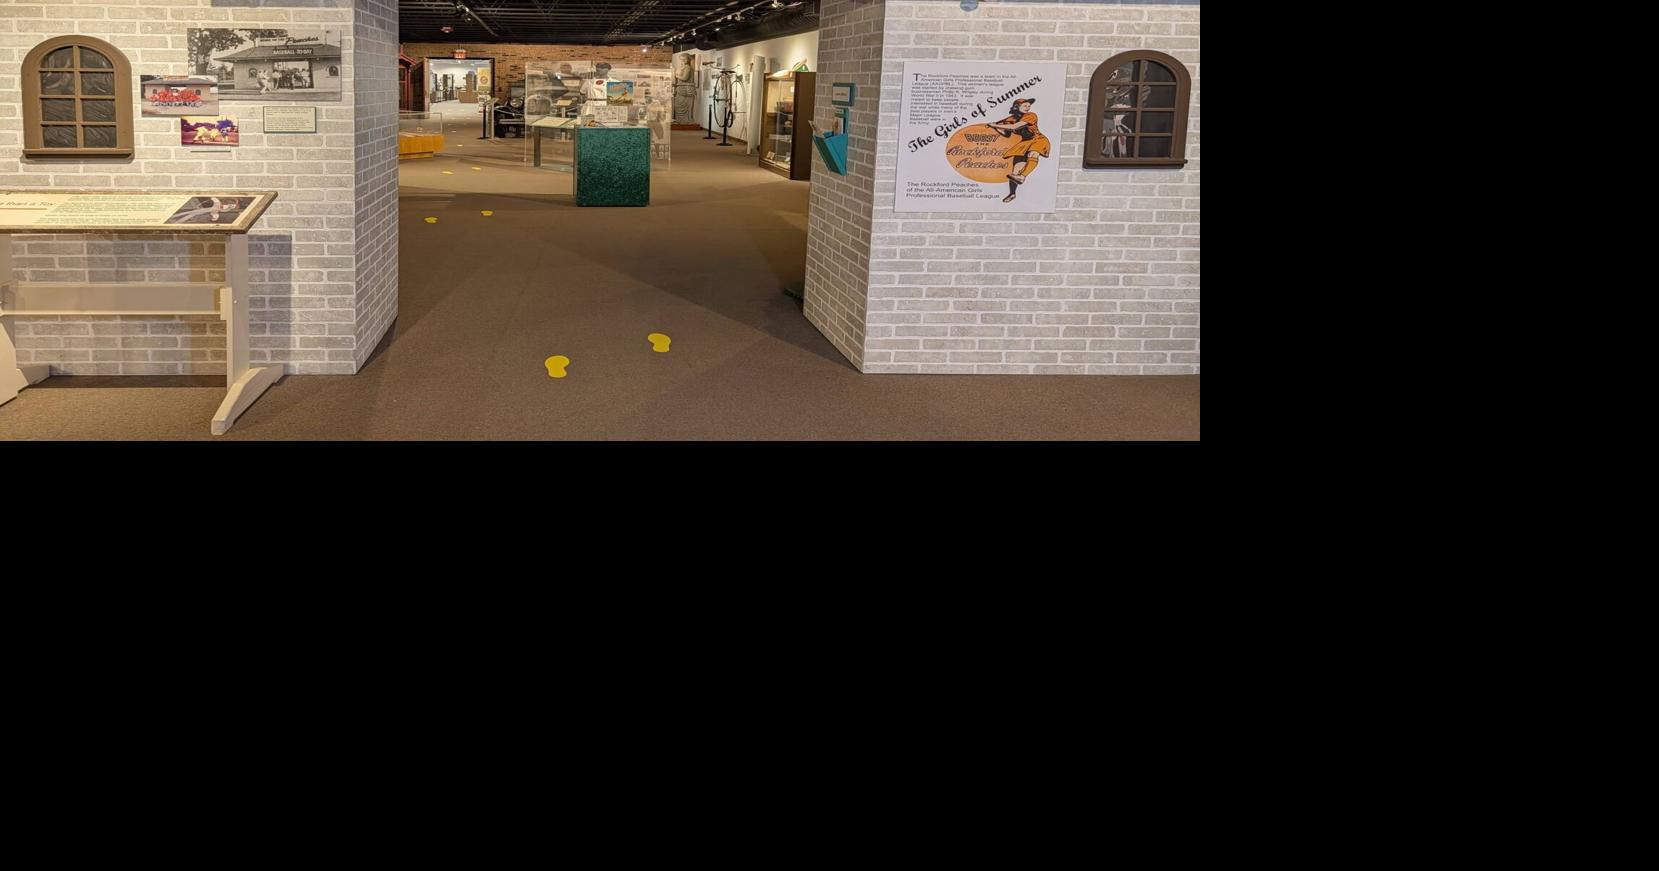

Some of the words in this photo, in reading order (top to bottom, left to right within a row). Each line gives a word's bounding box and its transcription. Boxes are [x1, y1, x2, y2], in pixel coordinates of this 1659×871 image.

[908, 134, 934, 153] The
[934, 116, 968, 138] Girls
[971, 104, 986, 118] of
[986, 75, 1042, 108] Summer
[964, 134, 1000, 142] BOOST
[946, 144, 1006, 158] Rockford
[956, 158, 1008, 169] Peaches
